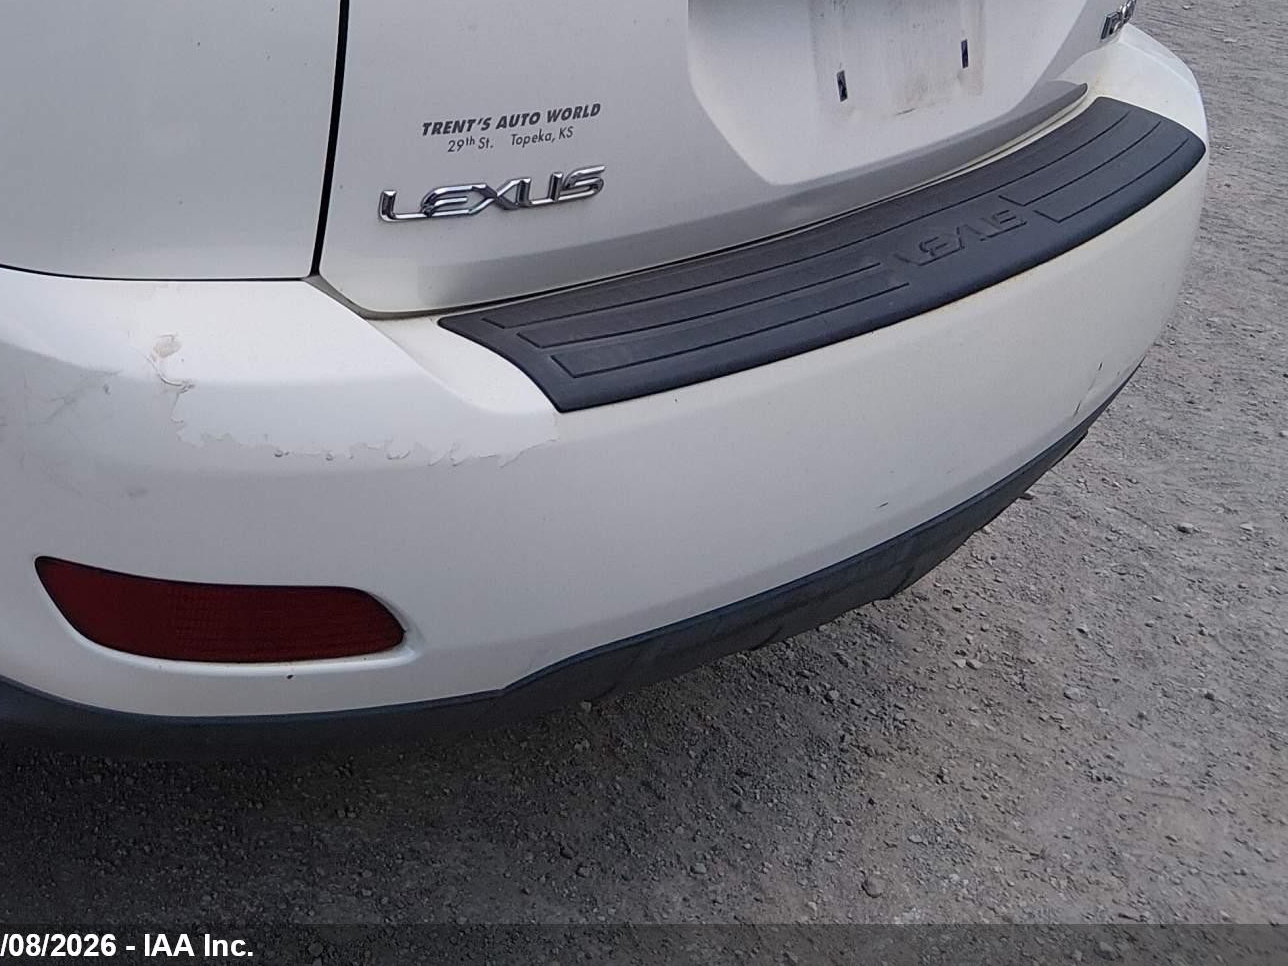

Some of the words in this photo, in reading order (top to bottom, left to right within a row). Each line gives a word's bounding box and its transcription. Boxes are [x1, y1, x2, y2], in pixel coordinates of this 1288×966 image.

[422, 117, 492, 136] TRENT'S
[496, 111, 541, 130] AUTO
[546, 103, 601, 123] WORLD
[447, 136, 475, 153] 29th
[478, 136, 494, 150] St.
[511, 129, 556, 148] Topeka,
[558, 126, 574, 140] KS
[378, 165, 606, 222] LEXUS
